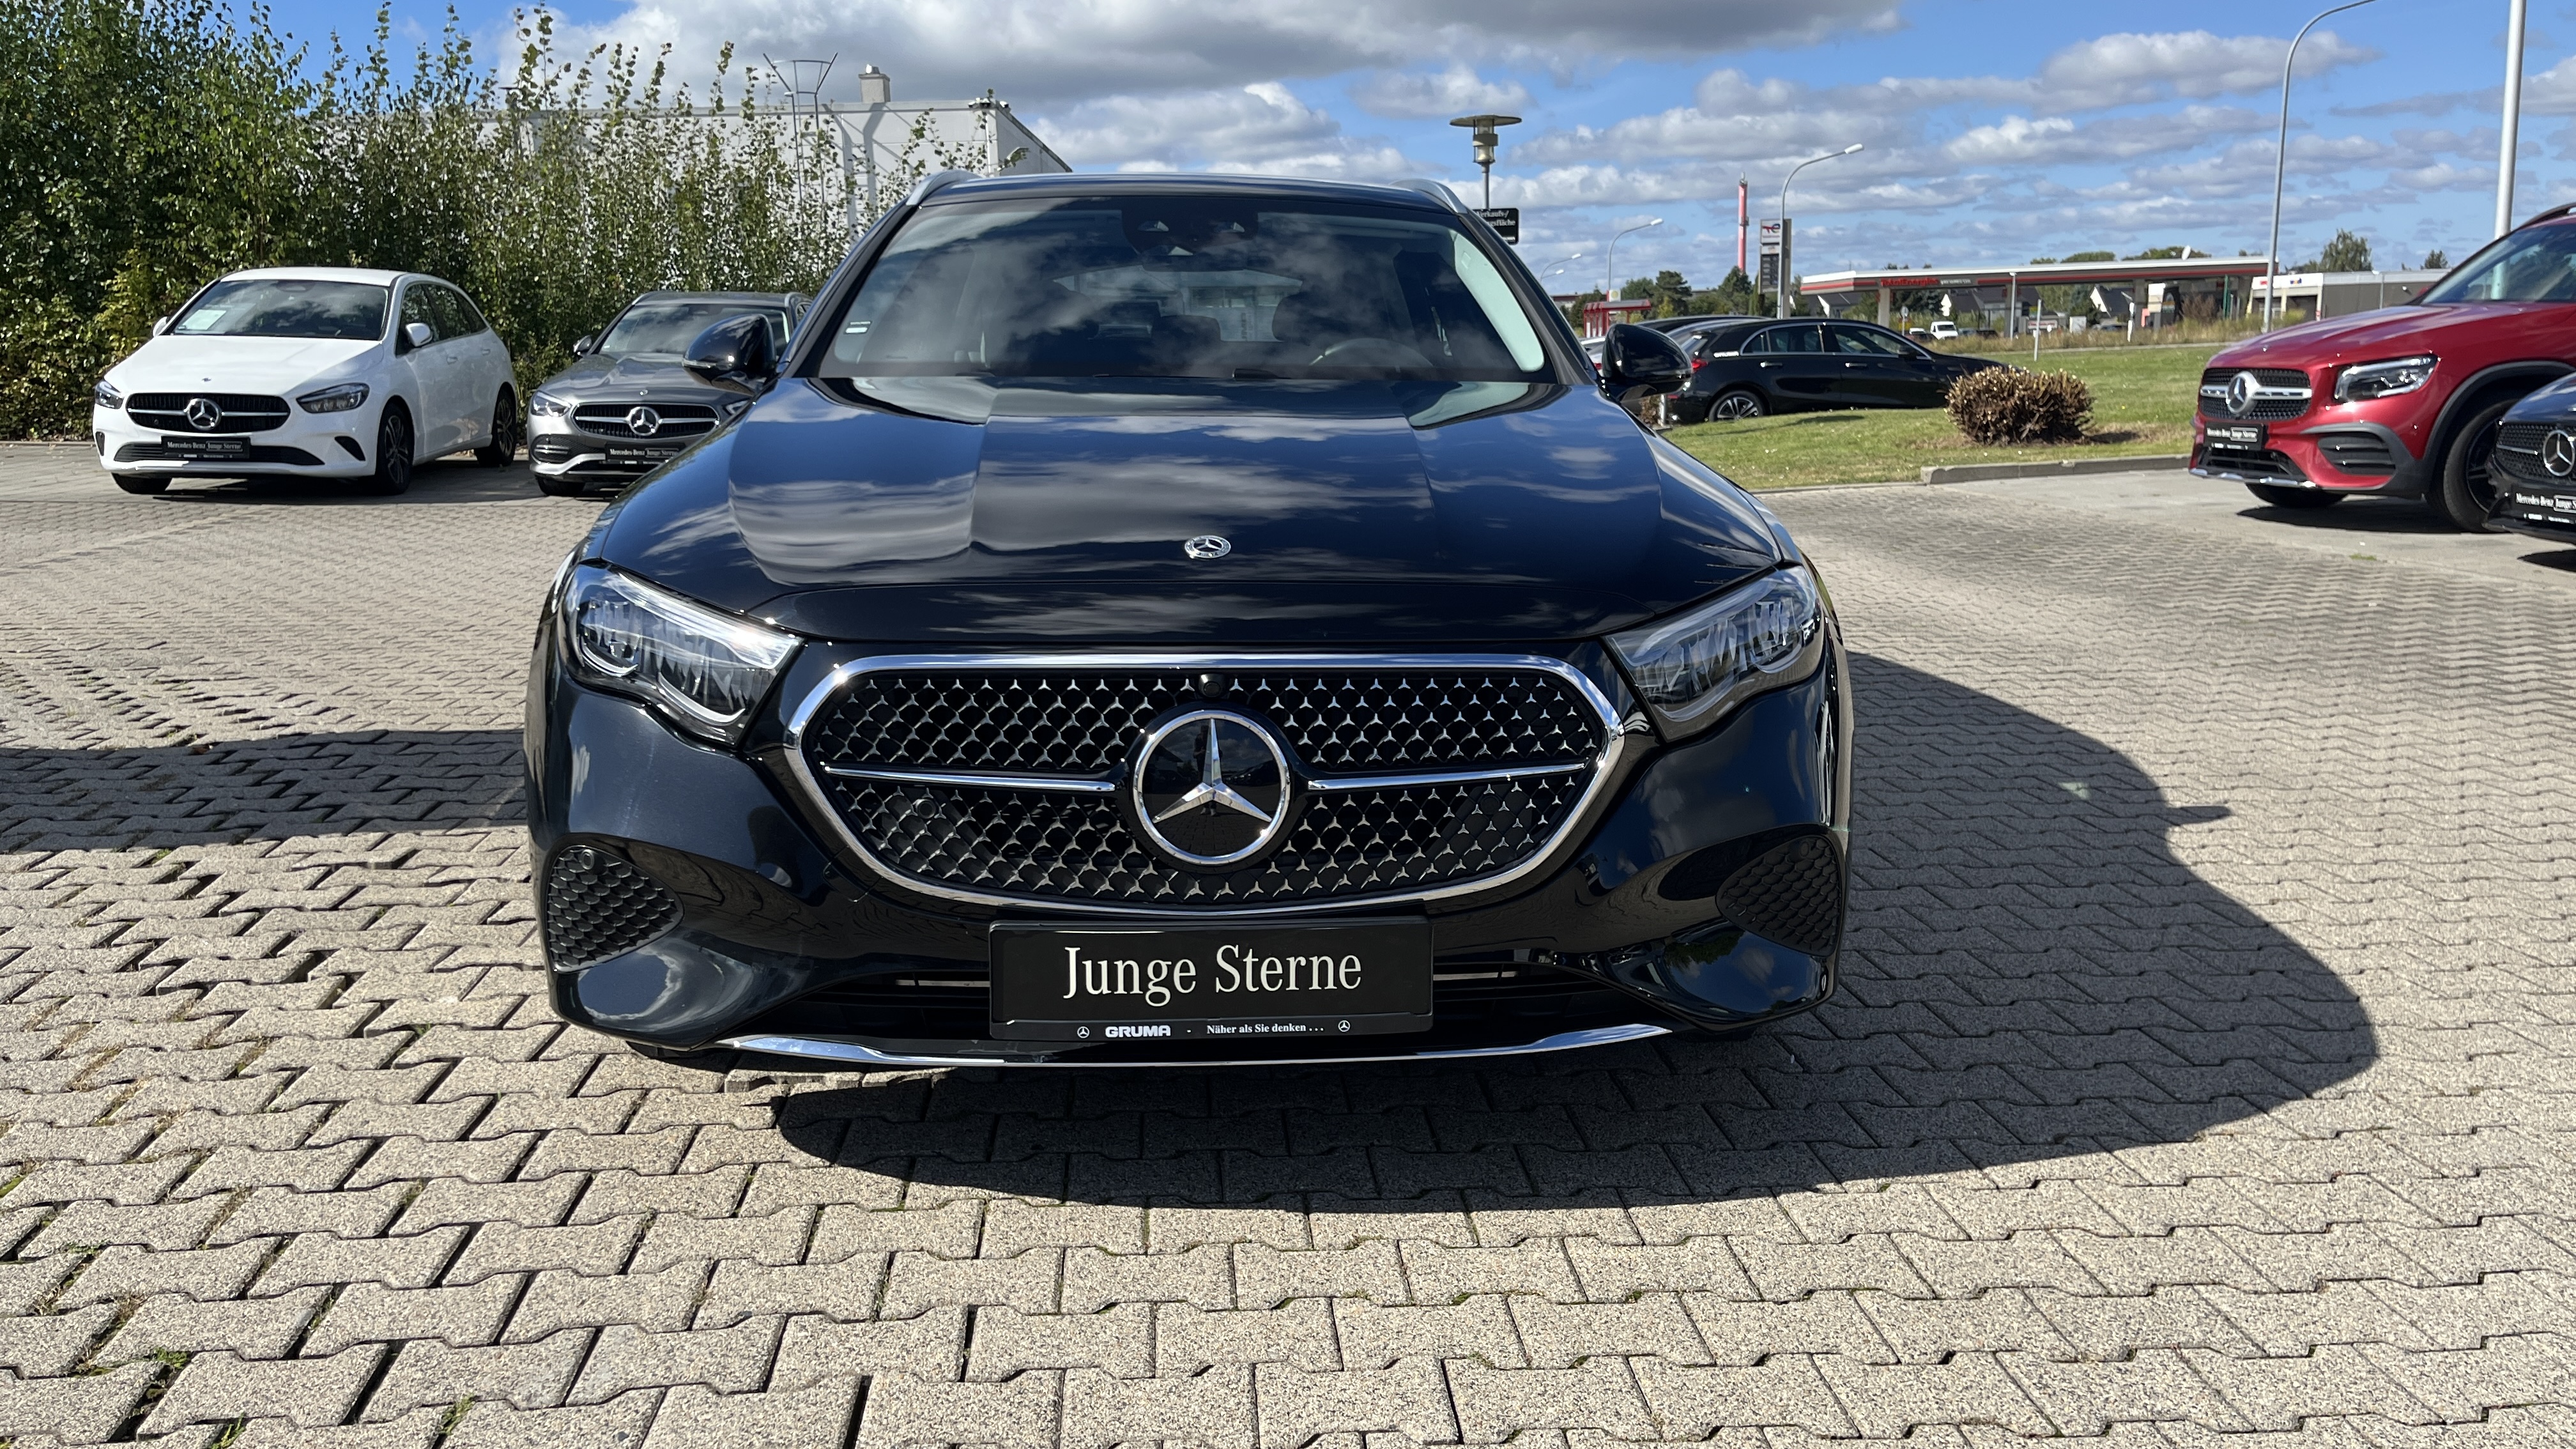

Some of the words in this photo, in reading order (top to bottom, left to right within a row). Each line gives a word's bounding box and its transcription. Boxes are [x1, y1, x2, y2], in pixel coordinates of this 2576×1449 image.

[1063, 947, 1197, 1007] Junge
[1215, 944, 1361, 993] Sterne
[1105, 1025, 1171, 1038] GRUMA
[1207, 1025, 1236, 1034] Näher
[1239, 1024, 1253, 1033] als
[1254, 1023, 1269, 1033] Sie
[1271, 1023, 1307, 1032] denken
